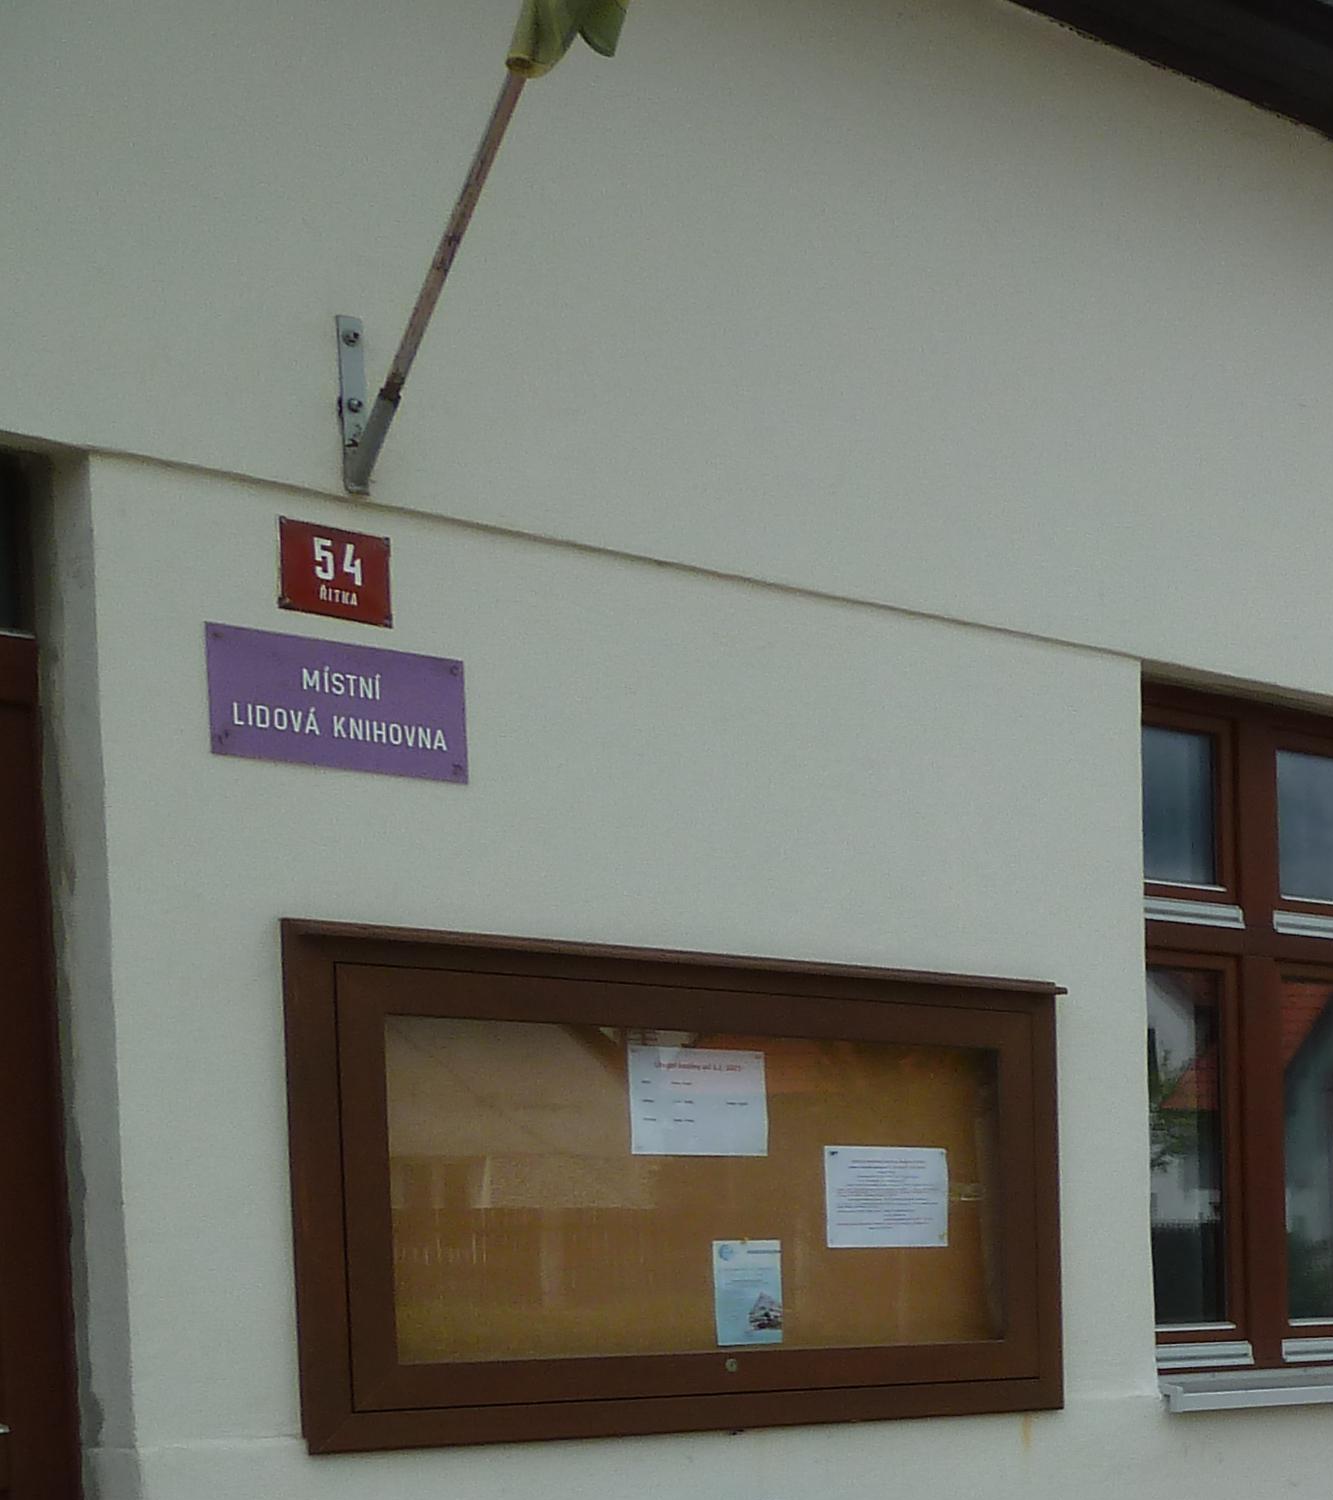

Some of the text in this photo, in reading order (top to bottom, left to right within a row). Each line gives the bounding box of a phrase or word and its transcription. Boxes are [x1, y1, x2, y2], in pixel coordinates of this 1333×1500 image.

[313, 536, 363, 588] 54
[319, 584, 358, 607] ŘITKA
[301, 666, 382, 701] MÍSTNÍ
[232, 701, 448, 752] LIDOVÁ KNIHOVNA
